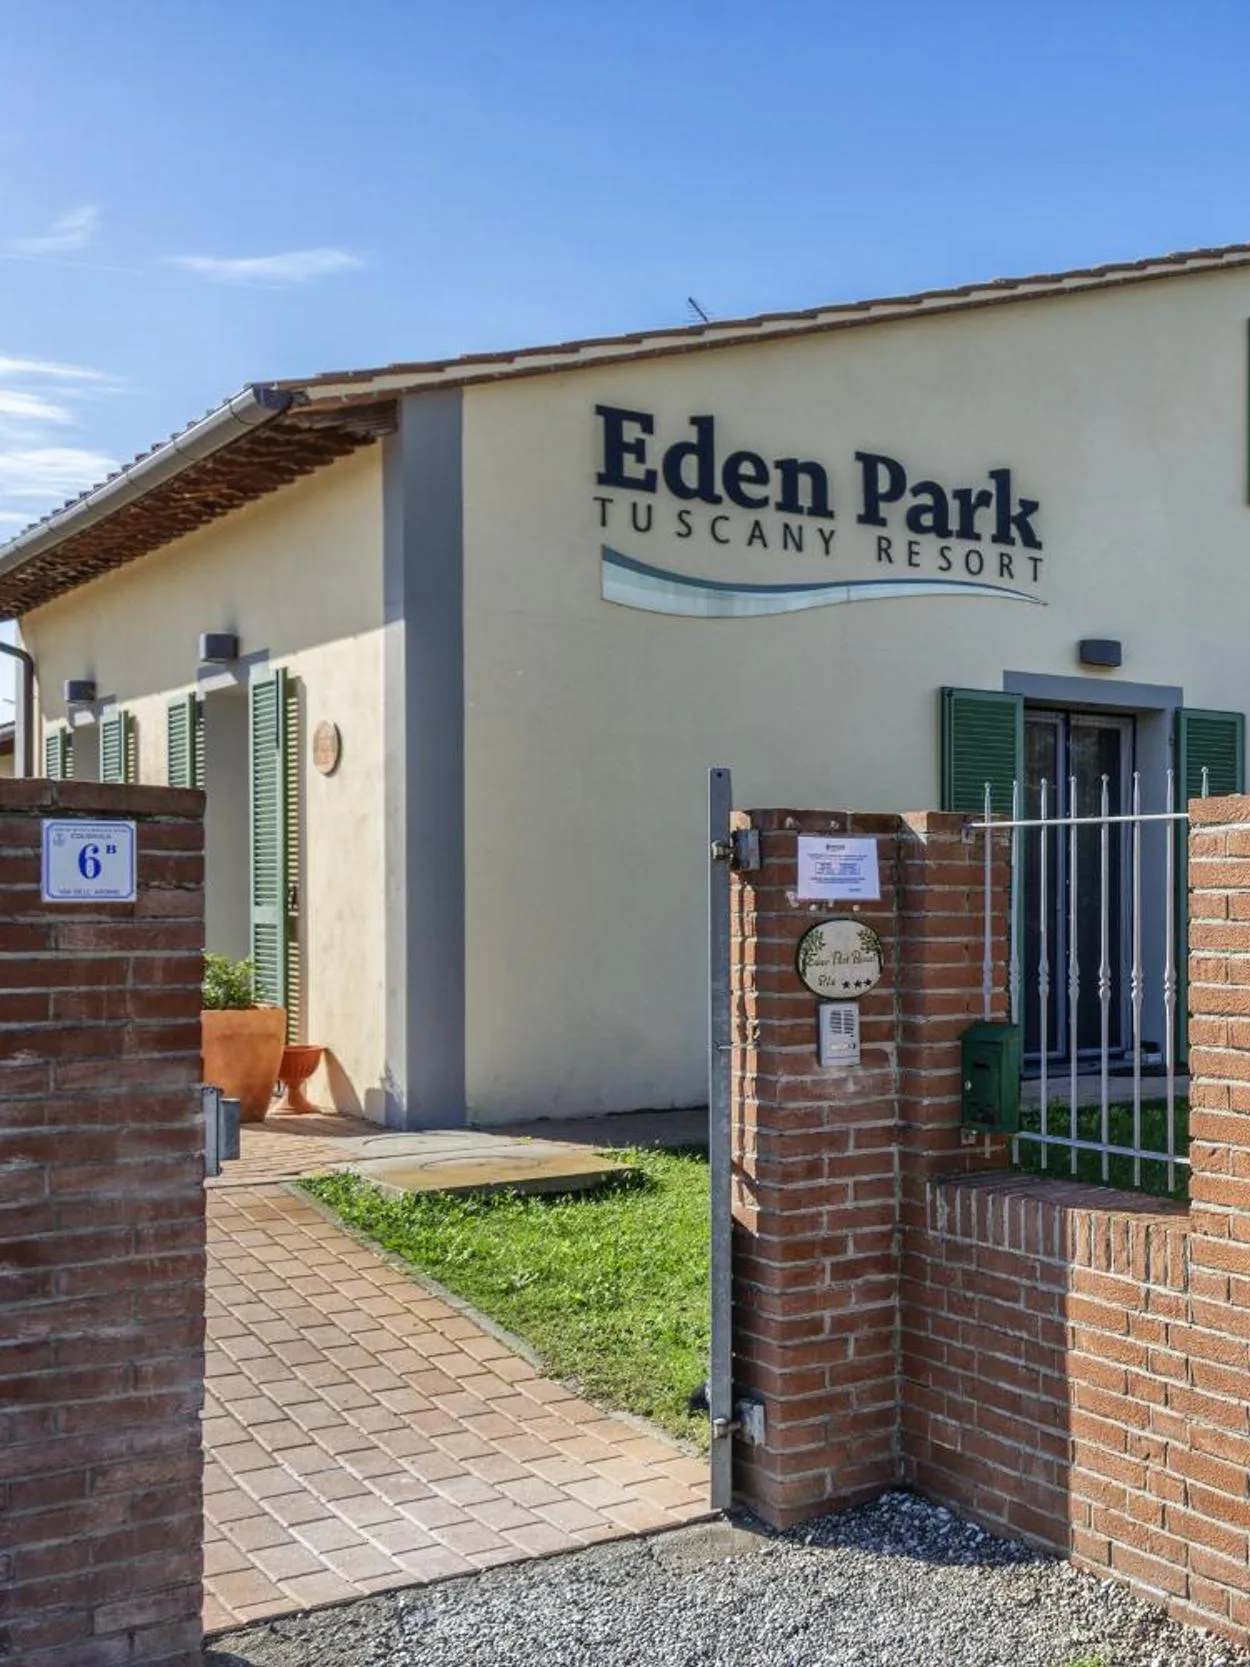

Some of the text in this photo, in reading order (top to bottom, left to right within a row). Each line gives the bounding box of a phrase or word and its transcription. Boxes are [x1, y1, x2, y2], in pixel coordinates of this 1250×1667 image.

[594, 403, 1044, 550] Eden Park
[593, 496, 1045, 583] TUSCANY RESORT
